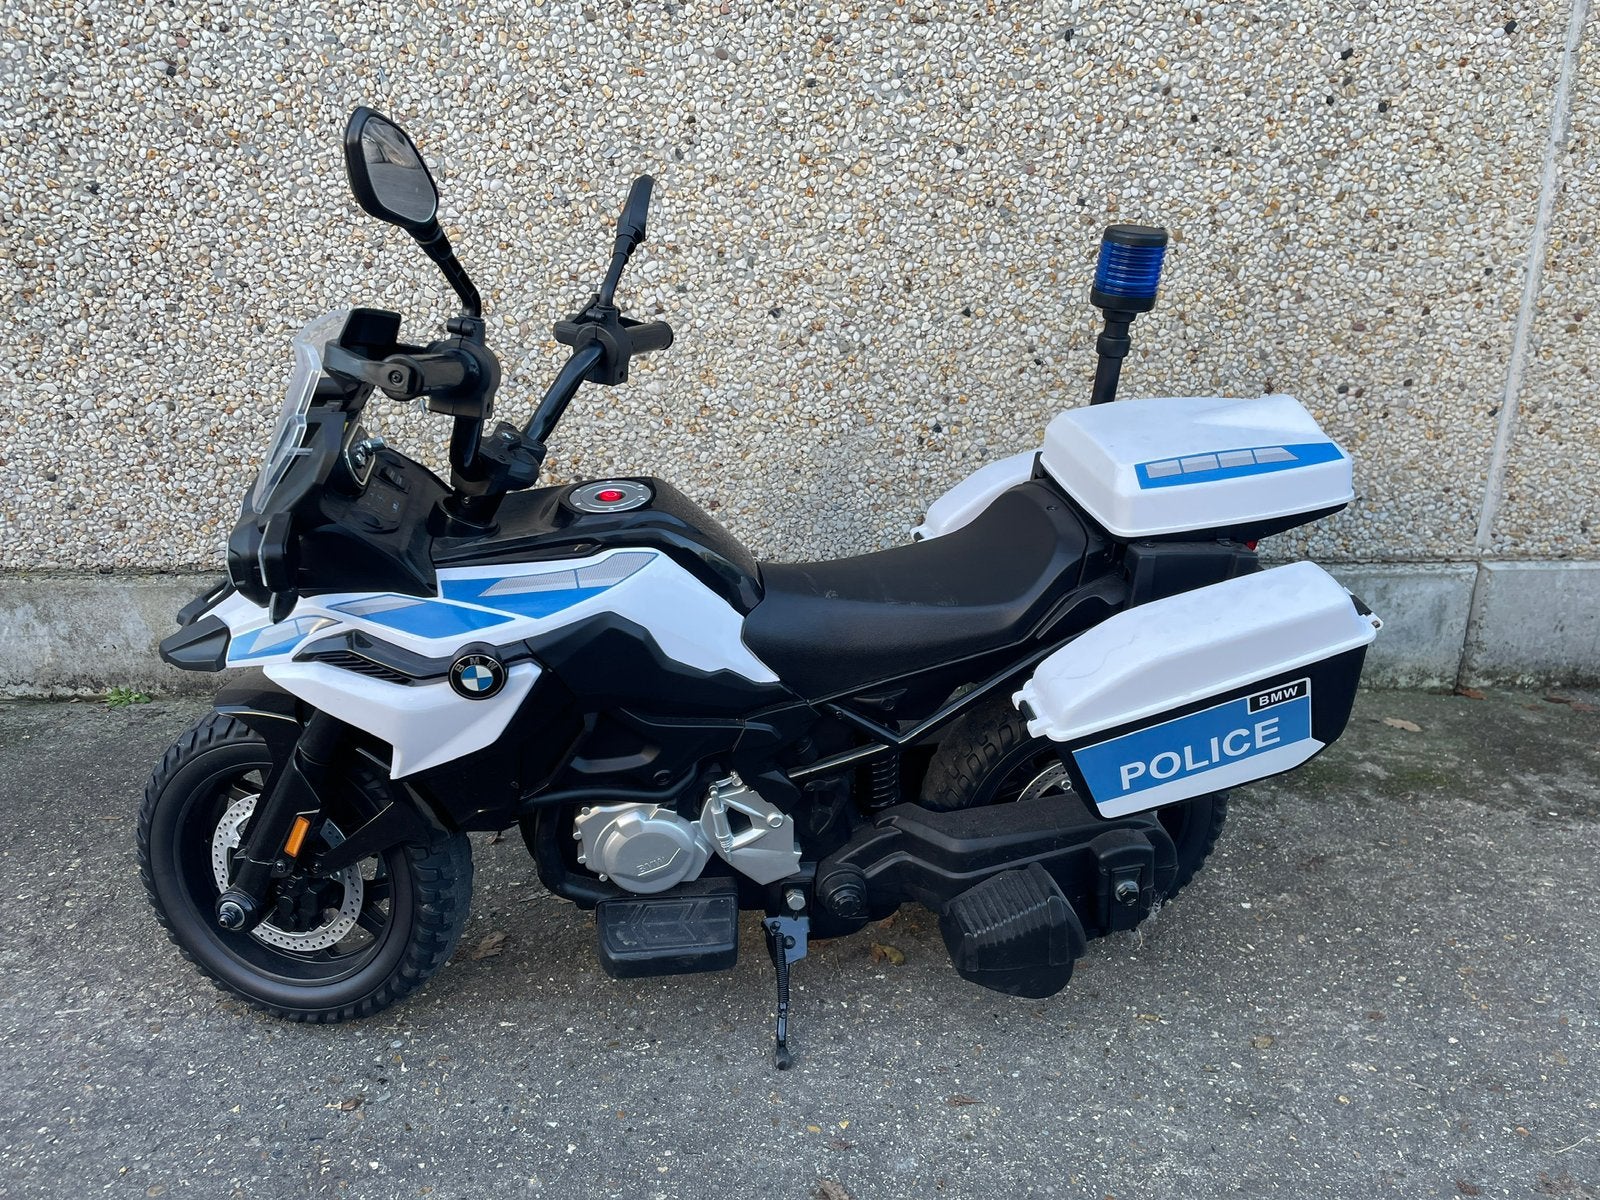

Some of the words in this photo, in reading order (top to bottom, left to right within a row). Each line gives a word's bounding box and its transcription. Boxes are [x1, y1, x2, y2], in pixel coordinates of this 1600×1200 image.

[455, 657, 498, 672] BMW
[1259, 686, 1299, 707] BMW
[1120, 717, 1281, 791] POLICE
